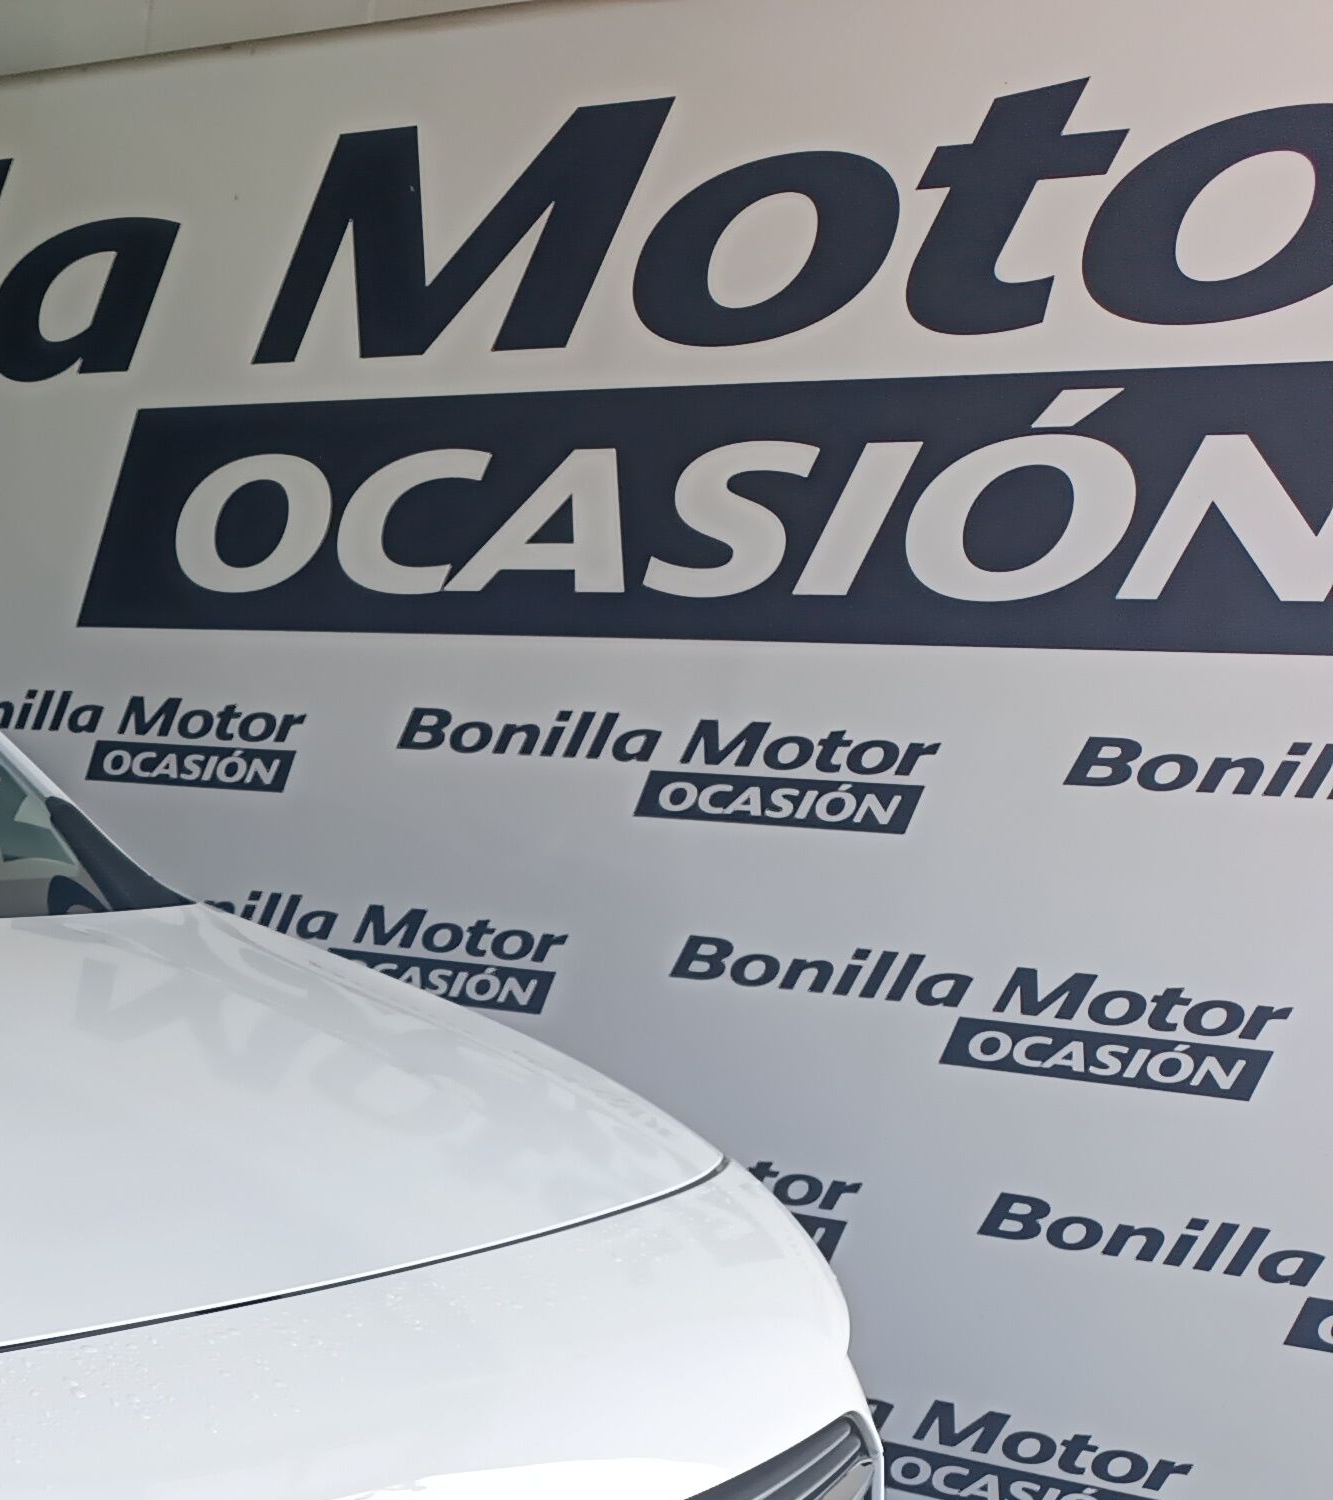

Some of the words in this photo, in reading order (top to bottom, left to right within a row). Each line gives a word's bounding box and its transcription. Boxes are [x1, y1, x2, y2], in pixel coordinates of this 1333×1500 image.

[117, 696, 307, 743] Motor
[397, 707, 661, 763] Bonilla
[680, 719, 941, 776] Motor
[103, 751, 281, 784] OCASIÓN
[658, 780, 902, 826] OCASIÓN
[353, 904, 568, 963] Motor
[669, 935, 973, 1008] Bonilla
[993, 967, 1293, 1041] Motor
[968, 1031, 1246, 1090] OCASIÓN
[976, 1192, 1325, 1287] Bonilla
[912, 1400, 1194, 1491] Motor
